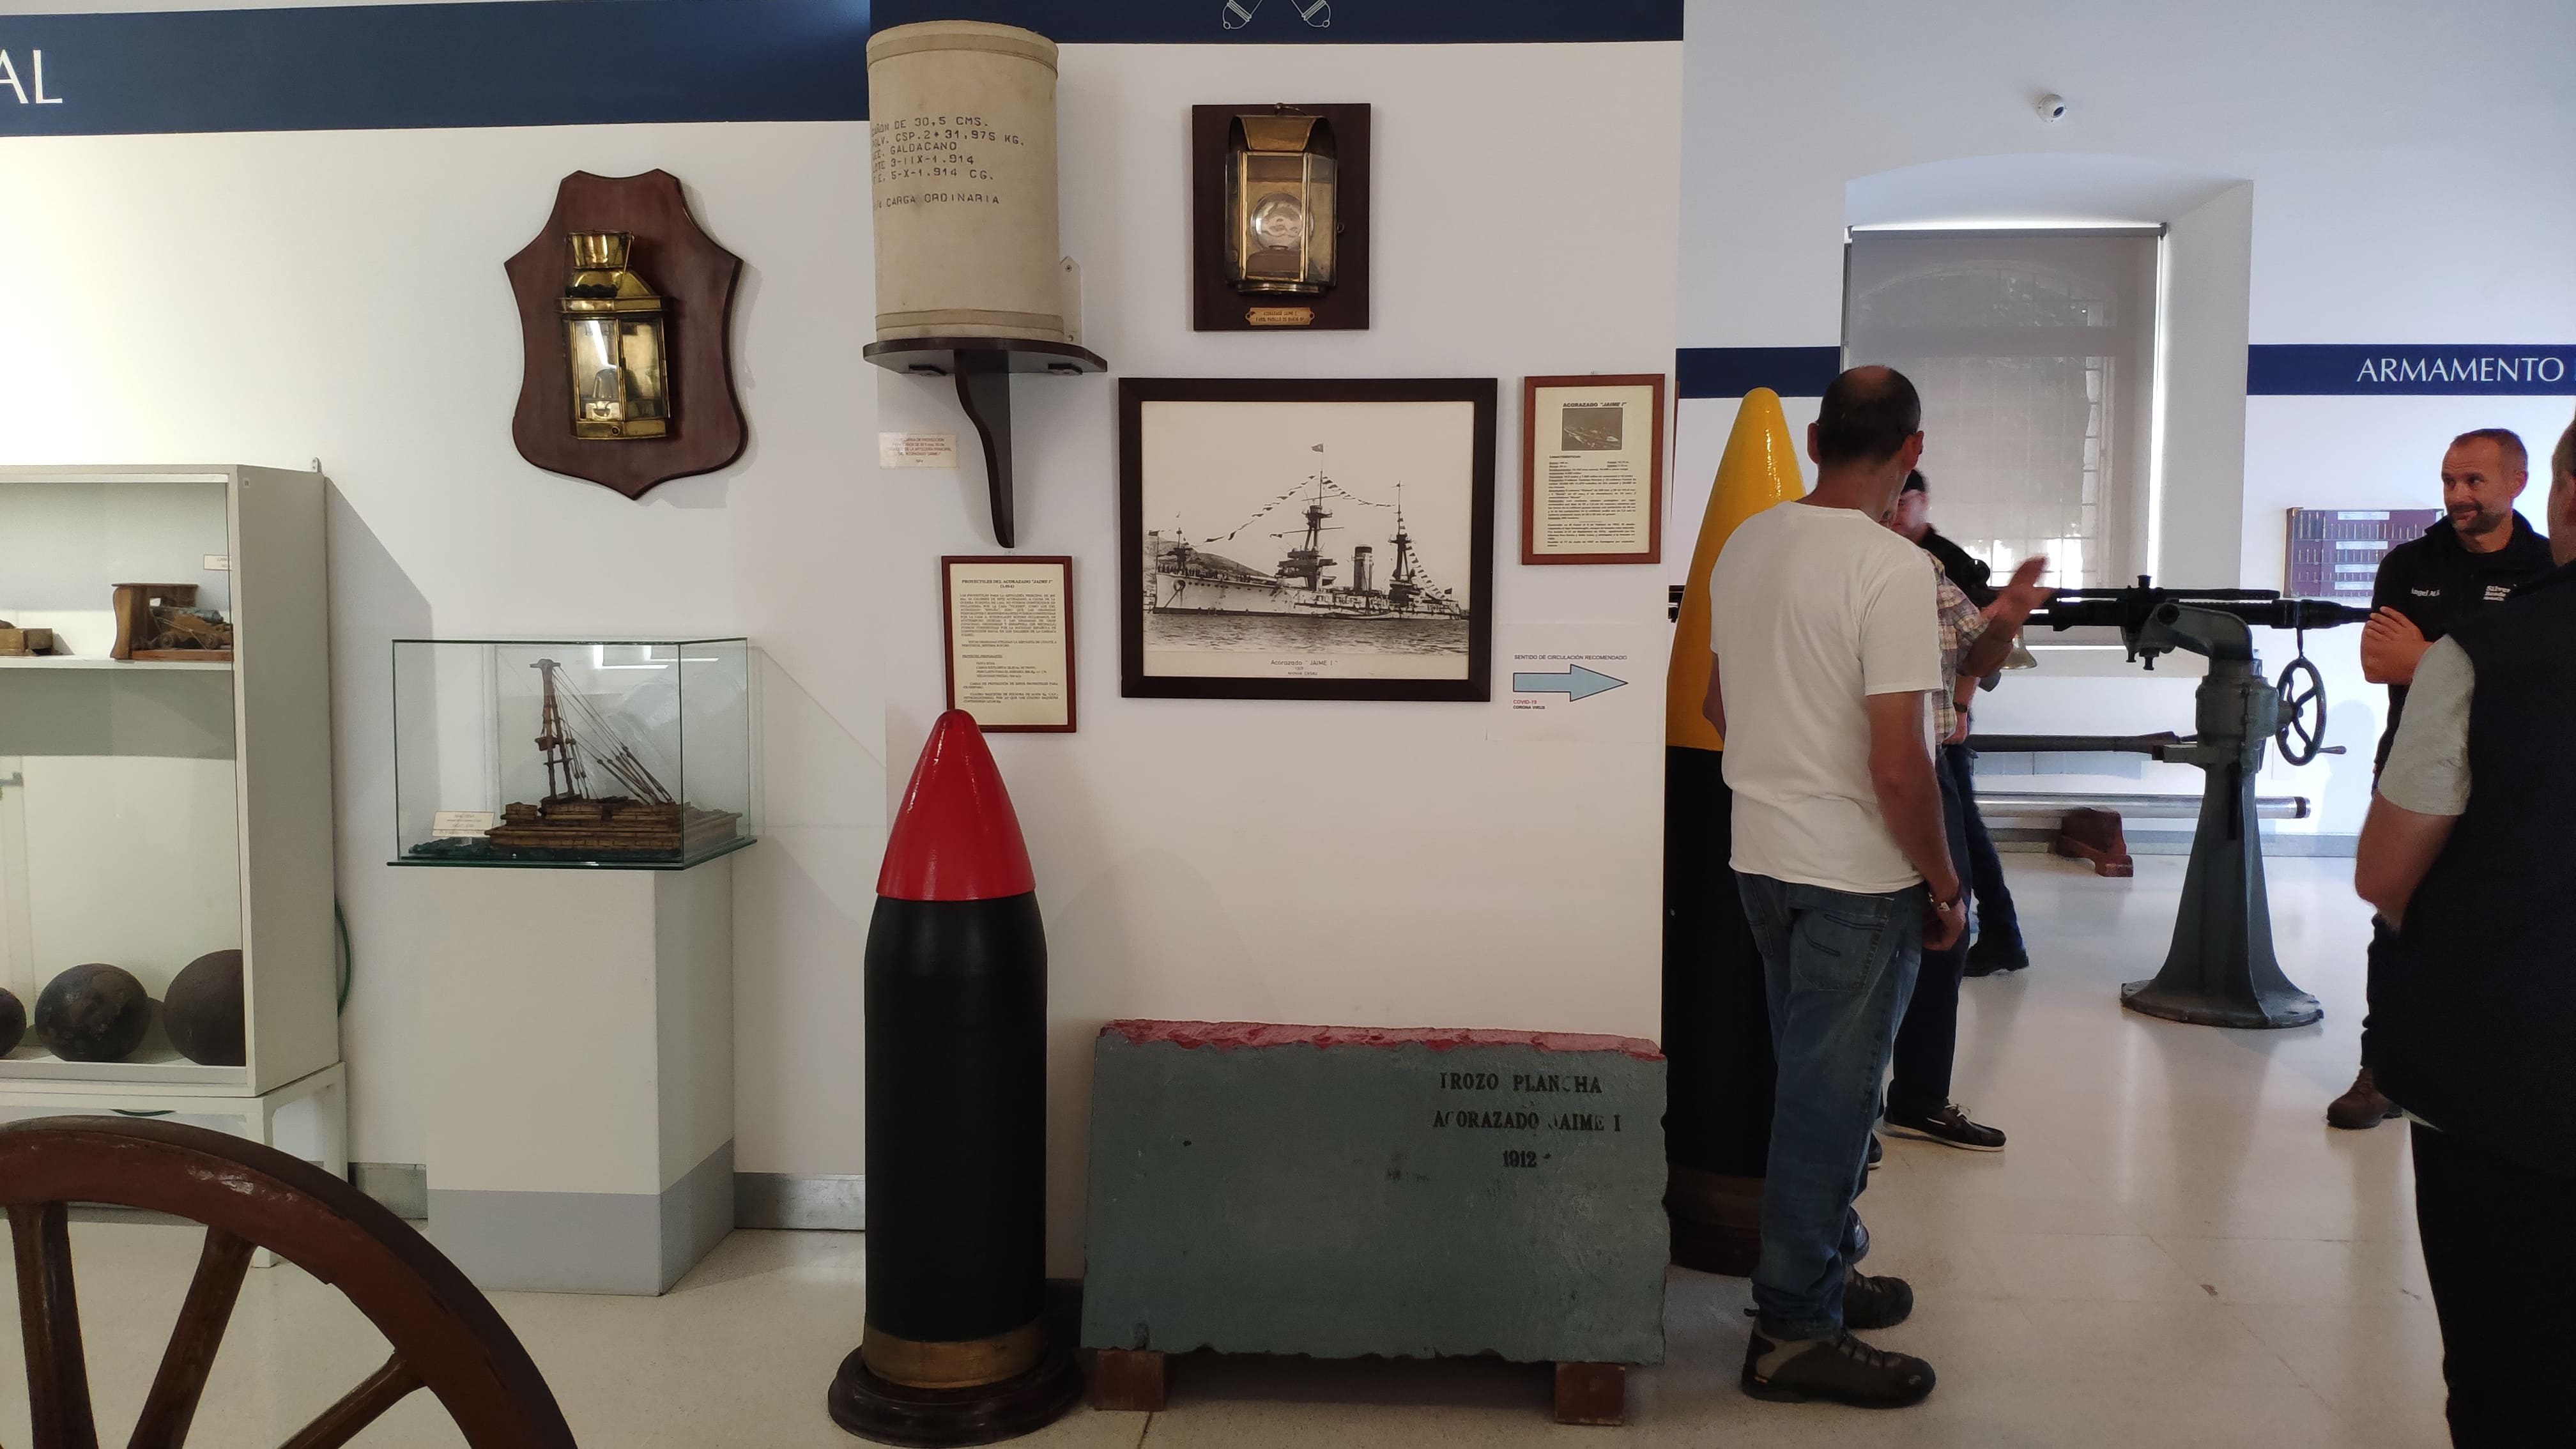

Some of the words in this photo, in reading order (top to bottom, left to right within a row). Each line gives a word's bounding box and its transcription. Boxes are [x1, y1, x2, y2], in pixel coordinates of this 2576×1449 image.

[894, 119, 907, 130] DE
[956, 116, 988, 127] CMS.
[1004, 134, 1024, 146] KG.
[890, 141, 957, 155] GALDACANO
[969, 169, 993, 180] CG.
[886, 195, 916, 208] CARGA
[924, 193, 1000, 204] ORDINARIA
[2356, 357, 2564, 382] ARMAMENTO
[1502, 1150, 1537, 1168] 1912
